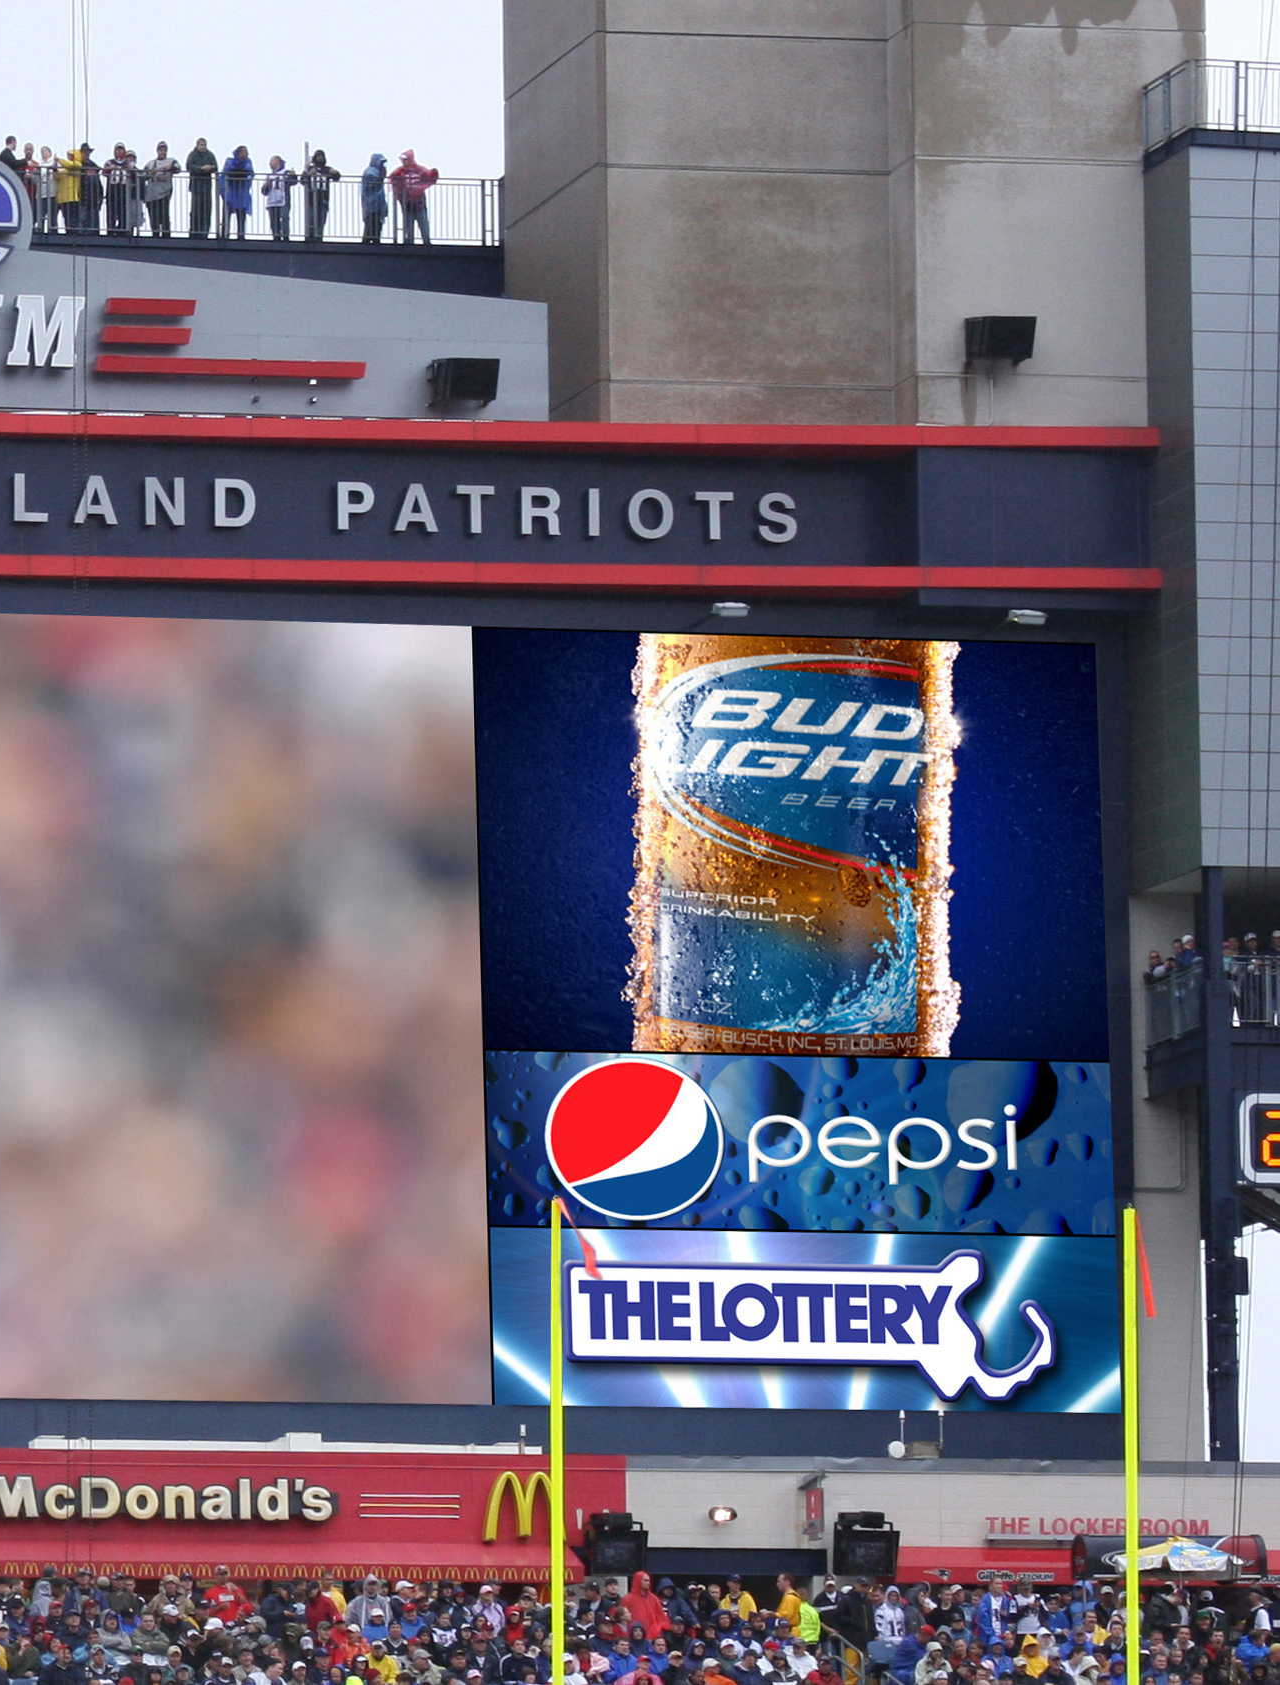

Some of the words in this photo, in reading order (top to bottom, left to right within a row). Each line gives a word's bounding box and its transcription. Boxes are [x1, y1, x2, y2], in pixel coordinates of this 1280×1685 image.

[335, 480, 798, 544] PATRIOTS
[690, 688, 925, 741] BUD
[780, 793, 897, 812] BEER
[659, 887, 778, 907] SUPERIOR
[659, 902, 817, 923] DRINKABILITY
[748, 1103, 1020, 1185] pepsi
[578, 1278, 696, 1342] THE
[697, 1282, 955, 1347] LOTTERY
[984, 1516, 1030, 1536] THE
[1138, 1518, 1210, 1537] ROOM
